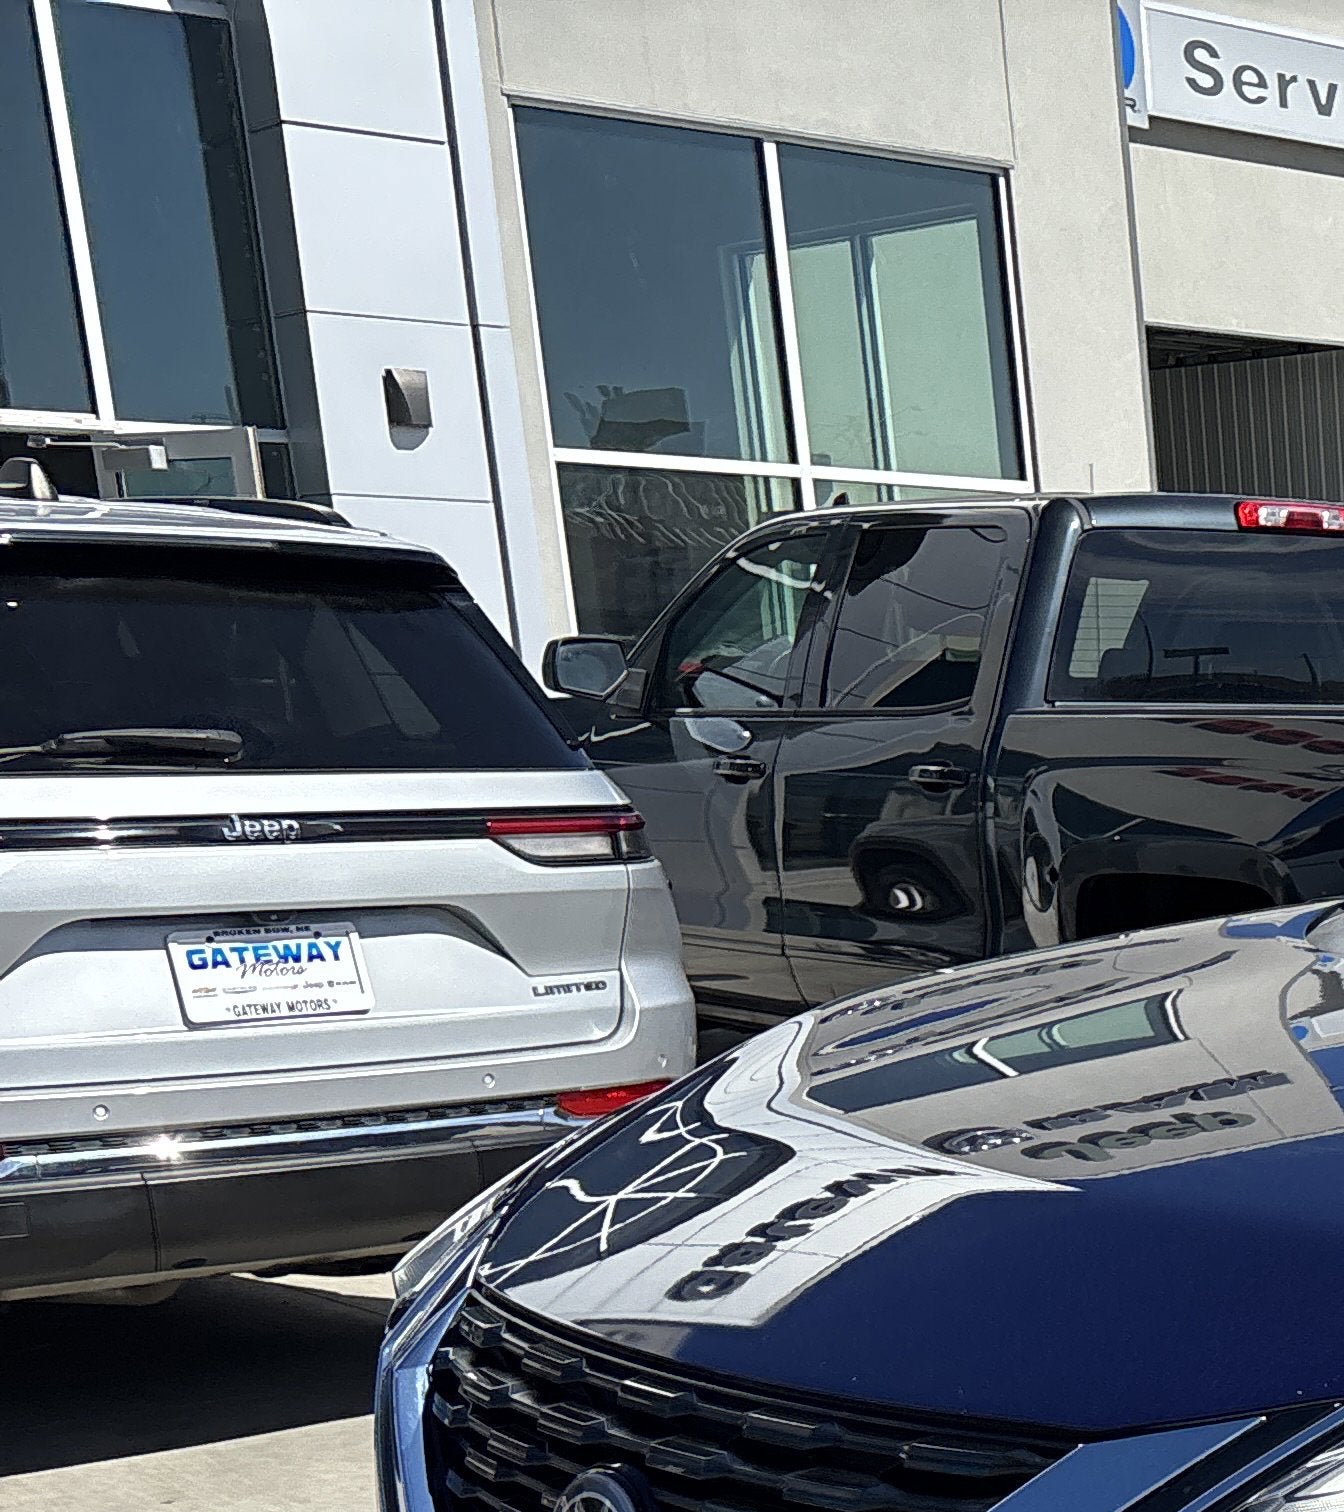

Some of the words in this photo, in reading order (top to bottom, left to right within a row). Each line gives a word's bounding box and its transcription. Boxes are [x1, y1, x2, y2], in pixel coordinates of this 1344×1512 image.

[222, 814, 301, 844] Jeep
[212, 929, 261, 938] BROKEN
[186, 940, 342, 971] GATEWAY
[236, 960, 308, 980] Motors
[532, 980, 608, 997] LIMITED
[232, 1001, 282, 1018] GATEWAY
[286, 998, 332, 1013] MOTORS
